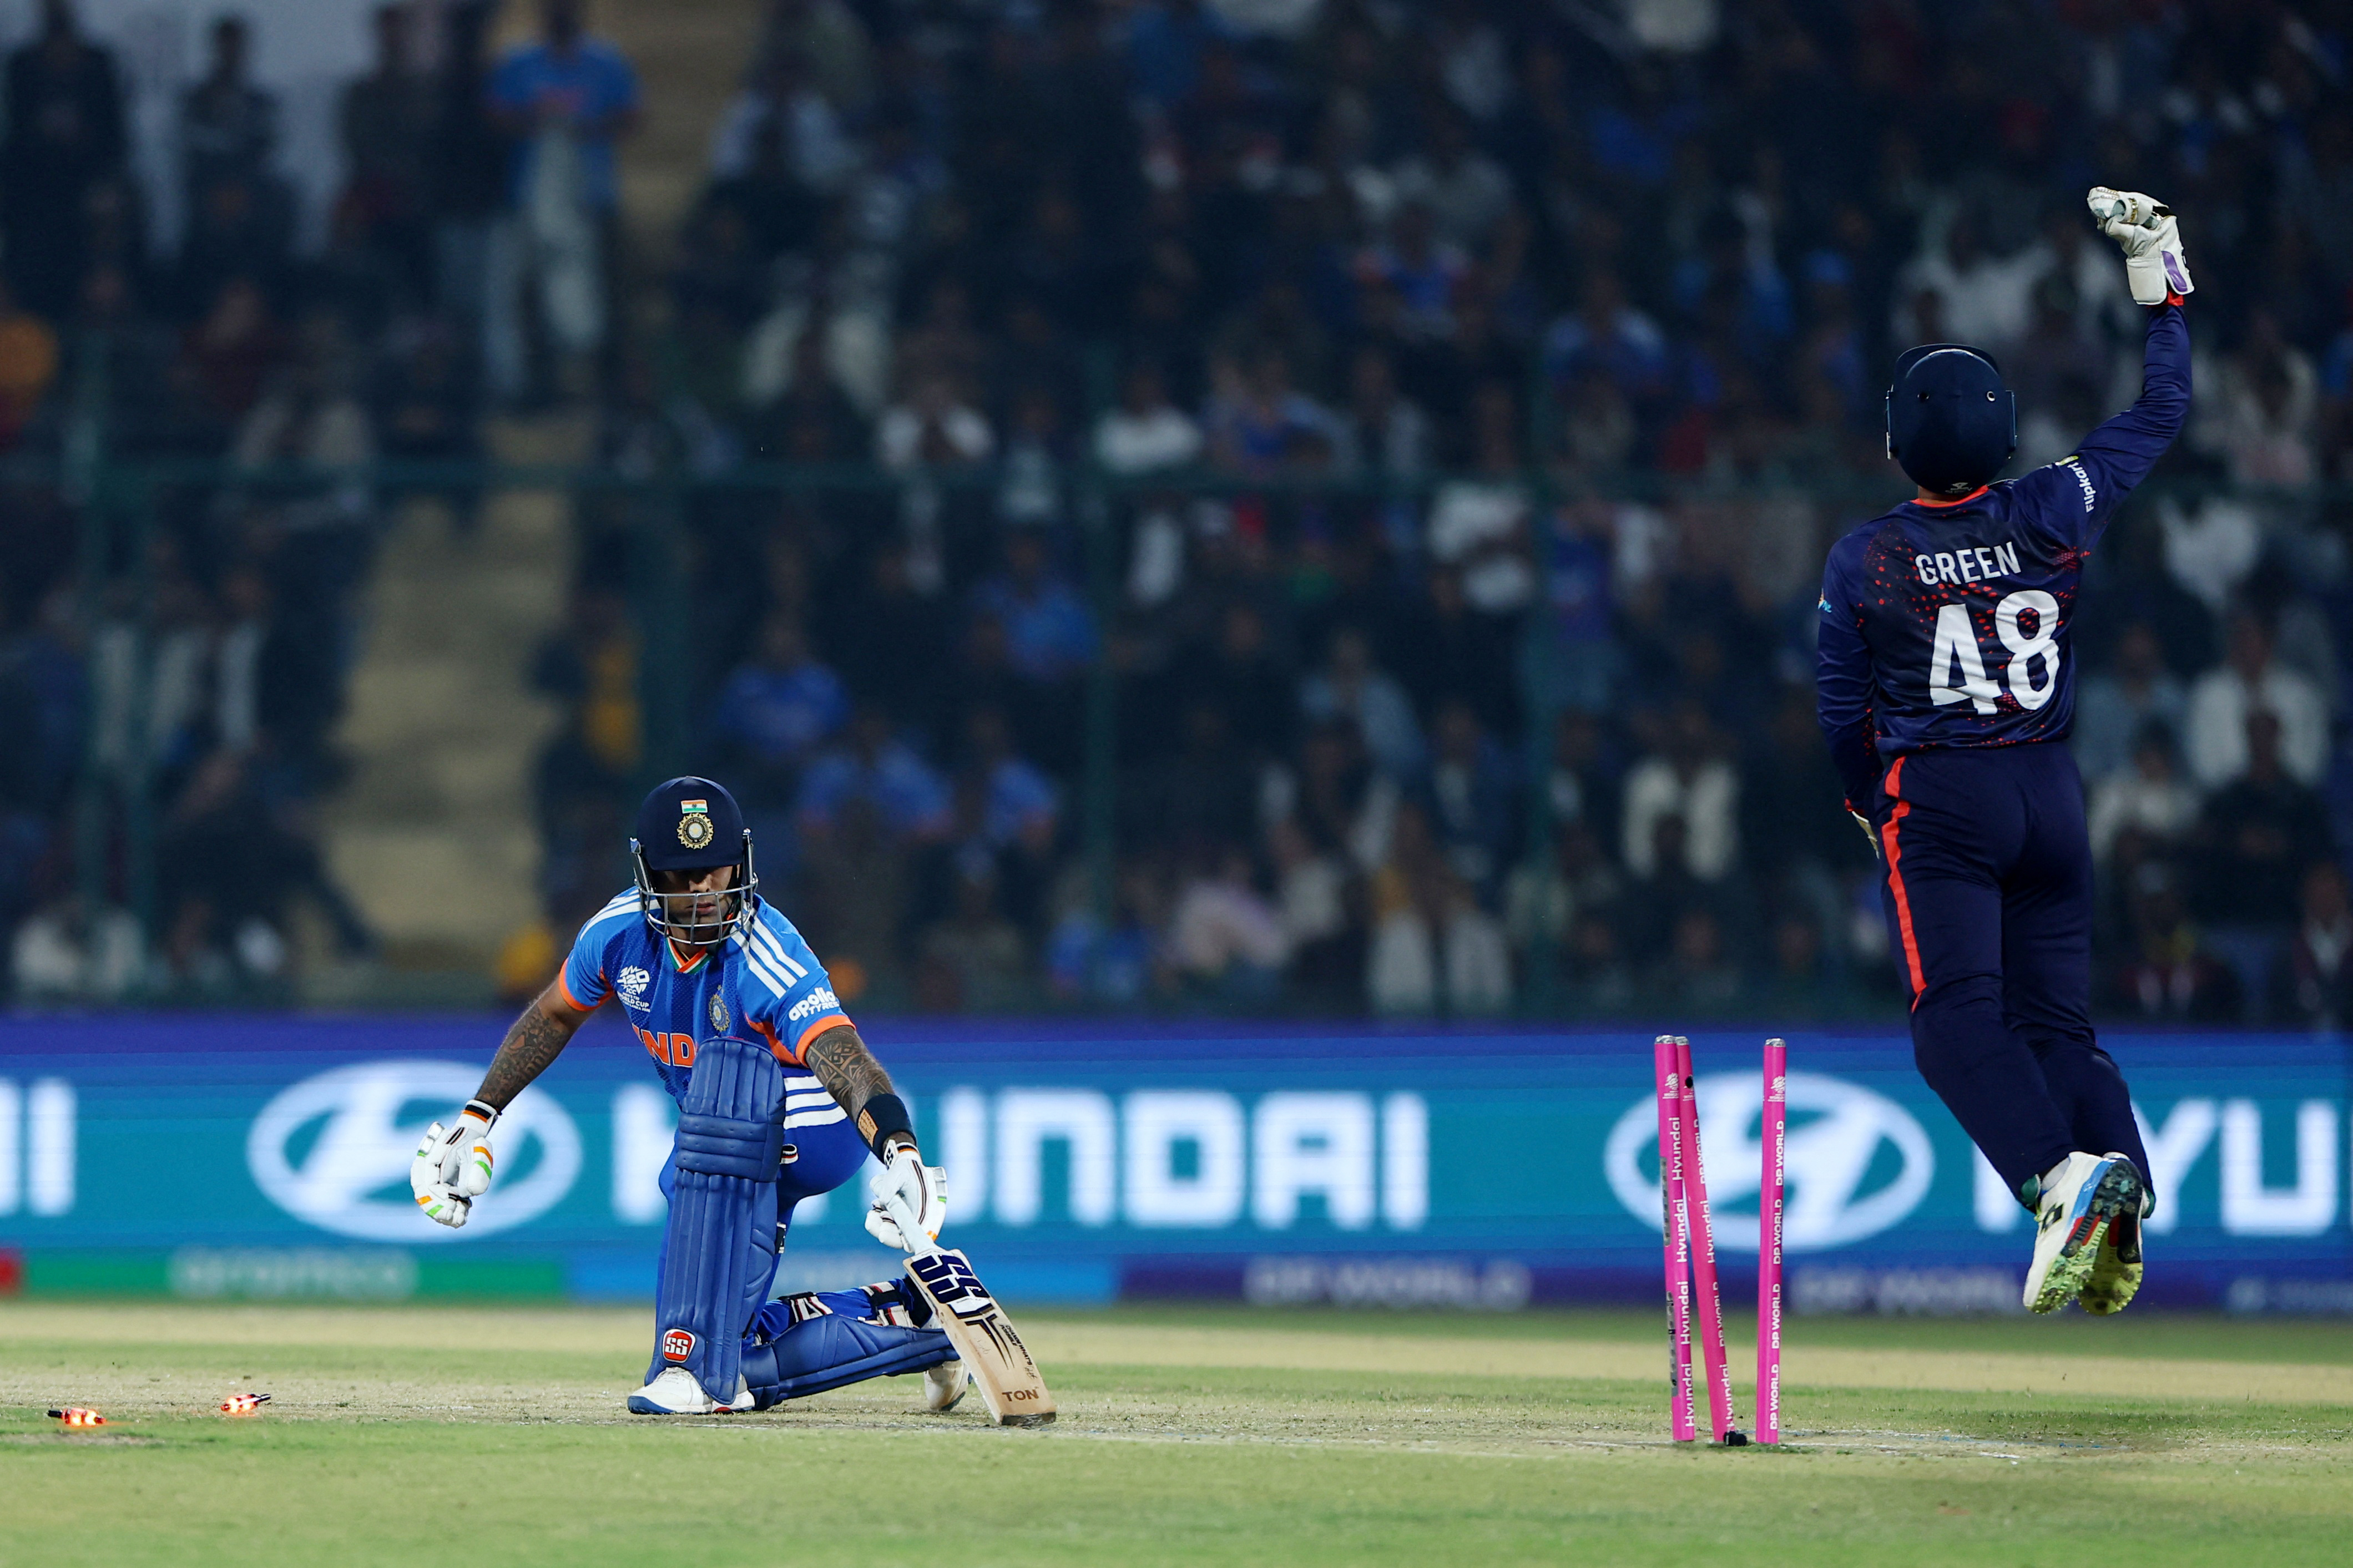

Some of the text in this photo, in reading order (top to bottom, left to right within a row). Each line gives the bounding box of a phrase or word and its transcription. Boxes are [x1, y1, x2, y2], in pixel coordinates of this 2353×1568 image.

[2067, 462, 2096, 513] Flipkart
[1915, 542, 2021, 585] GREEN
[1930, 590, 2060, 715] 48
[617, 991, 635, 1004] WORLD
[789, 987, 836, 1021] apollo
[809, 1001, 840, 1015] TYRES
[1669, 1117, 1682, 1180] Hyundai
[1776, 1120, 1784, 1186] DP WORLD
[1673, 1198, 1687, 1262] Hyundai
[1700, 1200, 1715, 1263] Hyundai
[1773, 1198, 1783, 1264] DP WORLD
[1677, 1281, 1690, 1345] Hyundai
[1771, 1283, 1781, 1349] DP WORLD
[665, 1337, 689, 1355] SS
[1002, 1389, 1039, 1402] TON
[1681, 1363, 1694, 1427] Hyundai
[1770, 1364, 1779, 1430] DP WORLD
